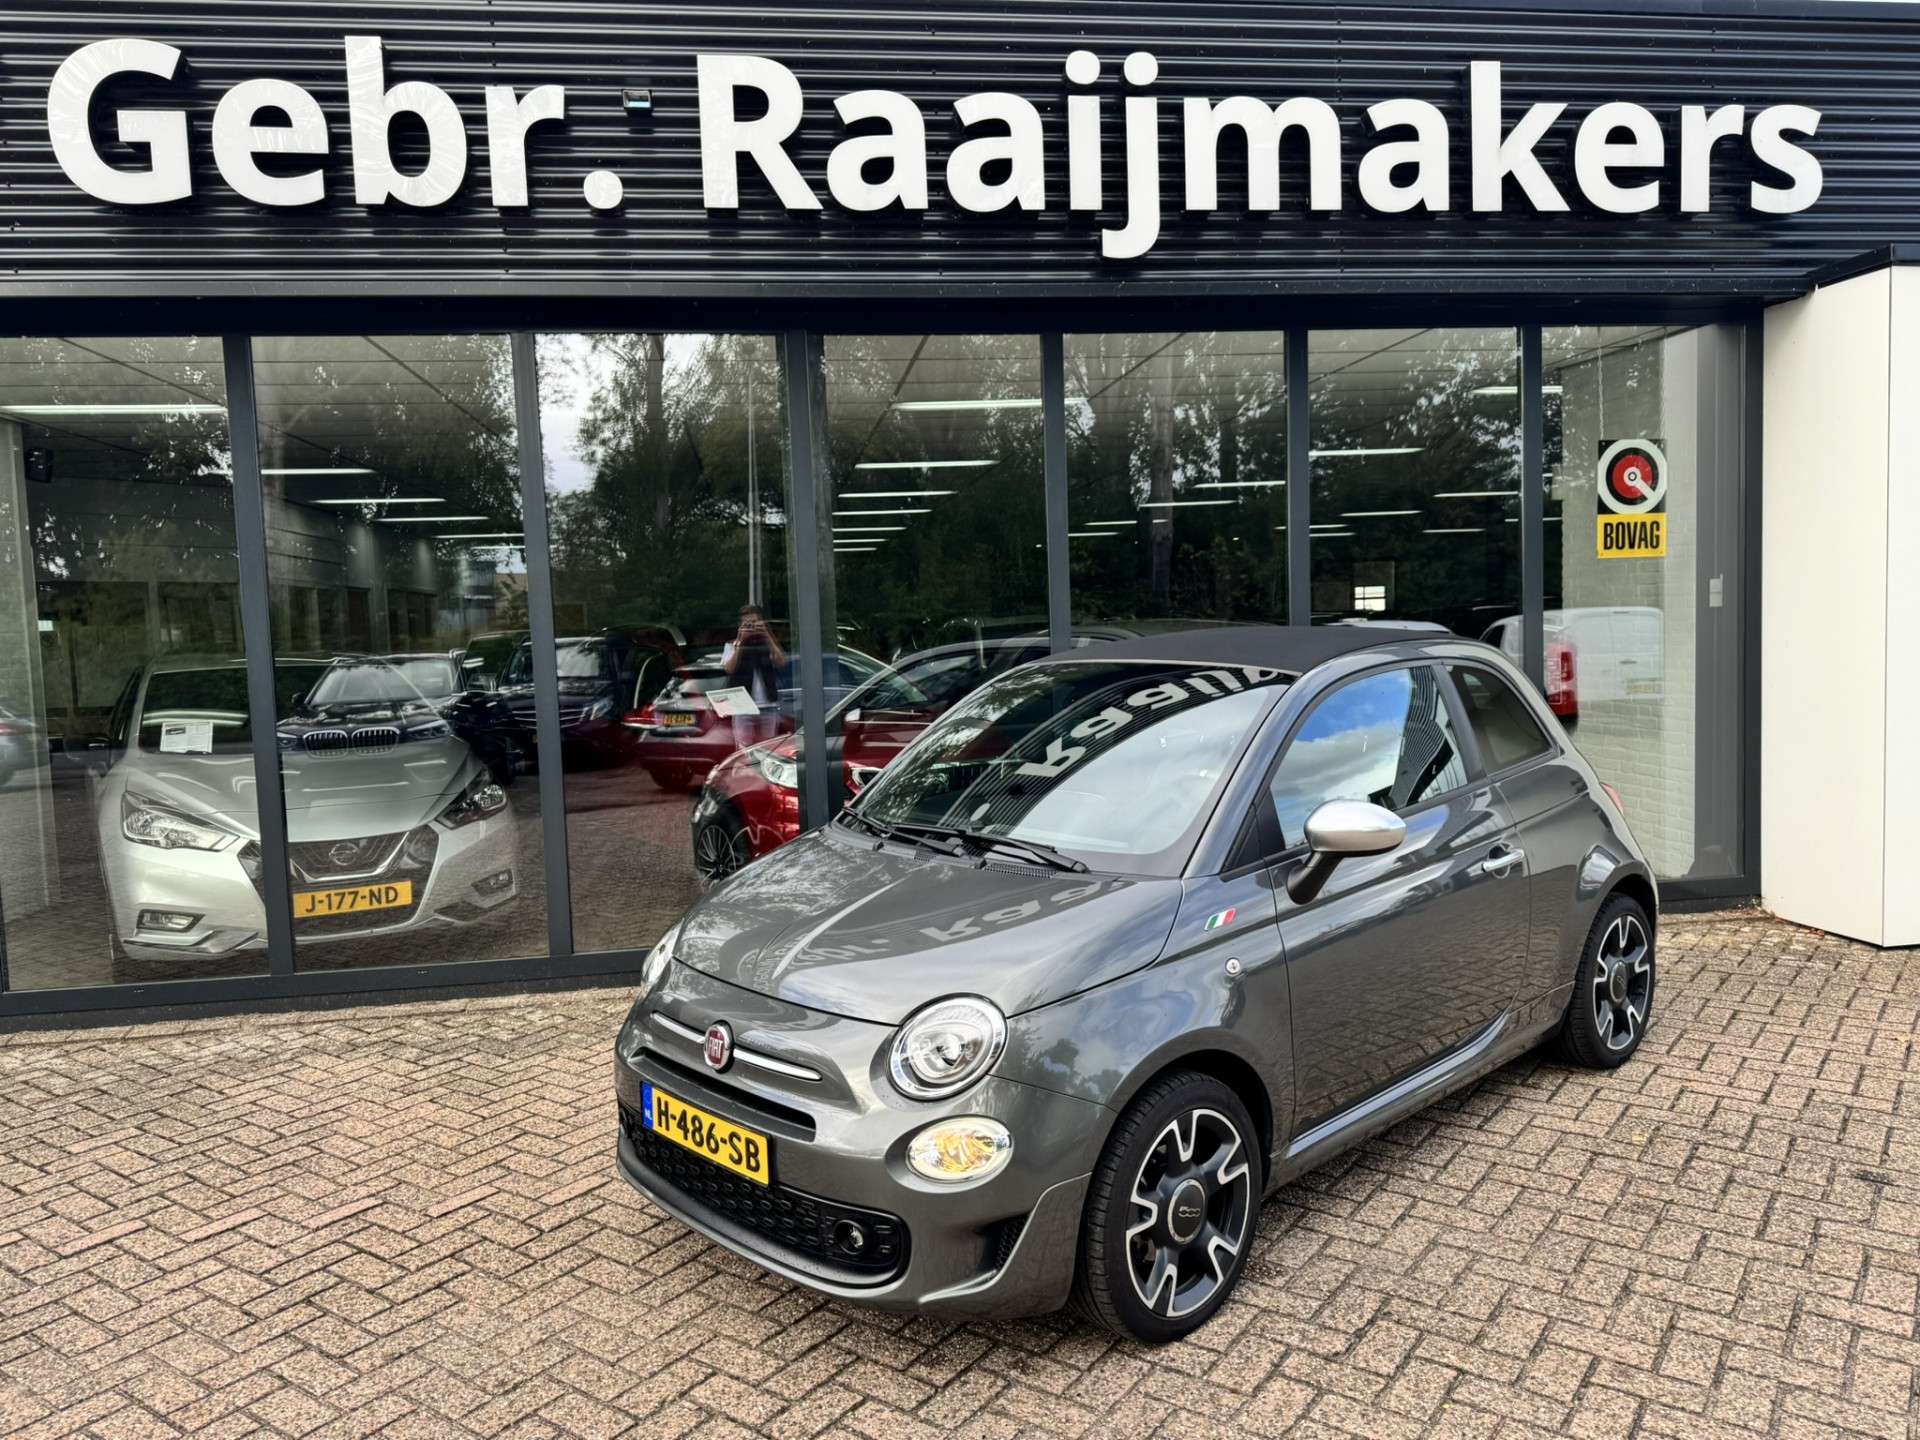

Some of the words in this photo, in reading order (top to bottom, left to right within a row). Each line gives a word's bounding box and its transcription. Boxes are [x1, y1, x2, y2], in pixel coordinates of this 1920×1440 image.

[47, 35, 624, 209] Gebr.
[696, 51, 1823, 260] Raaijmakers
[1604, 520, 1660, 550] BOVAG
[305, 886, 399, 913] J-177-ND
[656, 1096, 761, 1173] H-486-SB
